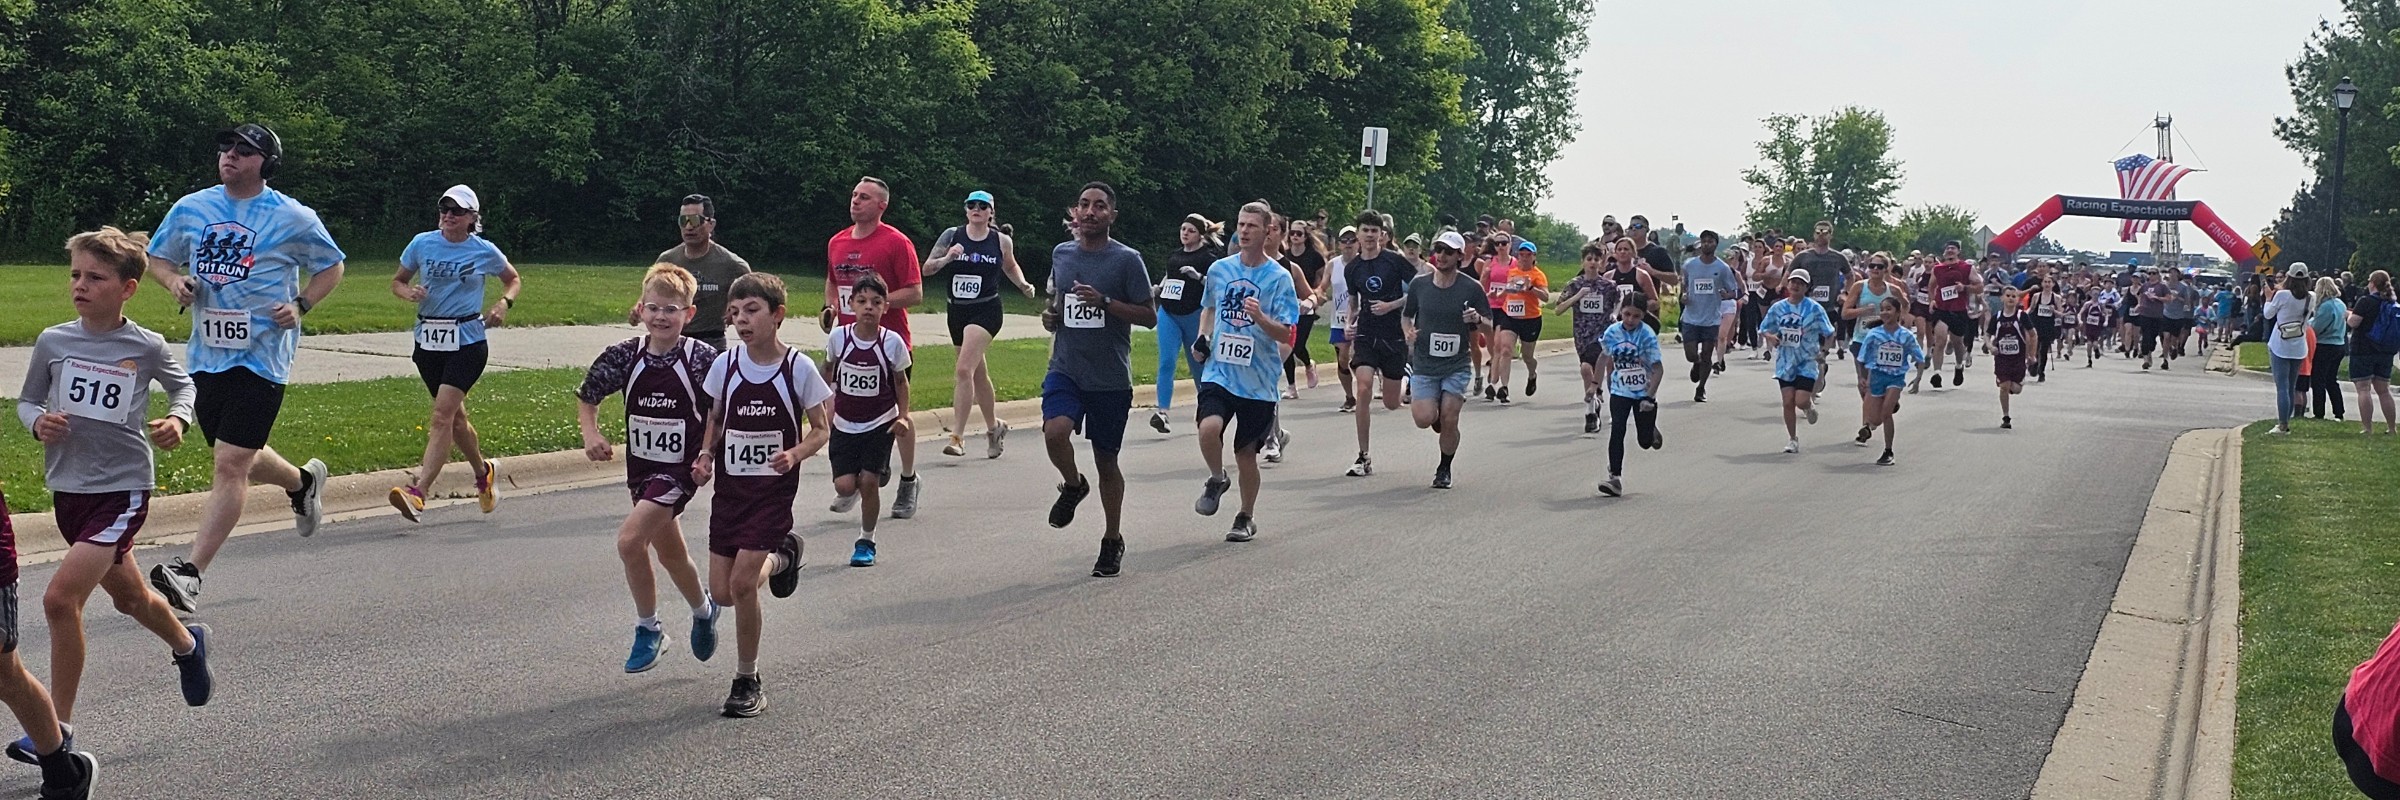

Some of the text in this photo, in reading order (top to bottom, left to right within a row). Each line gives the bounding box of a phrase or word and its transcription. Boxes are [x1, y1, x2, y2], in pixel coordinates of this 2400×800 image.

[2066, 200, 2188, 216] Racing Expectations
[2014, 213, 2044, 238] START
[2207, 222, 2237, 248] FINISH
[198, 262, 246, 277] 911 RUN
[426, 259, 460, 270] FLEET
[427, 269, 456, 278] FEET
[955, 281, 980, 293] 1469
[1066, 304, 1103, 320] 1264
[1507, 304, 1524, 312] 1207
[1583, 300, 1600, 310] 505
[1222, 310, 1236, 319] 911
[203, 319, 248, 340] 1165
[423, 328, 456, 344] 1471
[1220, 341, 1252, 359] 1162
[1434, 340, 1454, 352] 501
[1879, 352, 1902, 362] 1139
[71, 361, 130, 378] Racing Expectations
[842, 372, 878, 389] 1263
[1620, 373, 1646, 386] 1483
[69, 376, 122, 409] 518
[638, 396, 677, 409] WILDCATS
[736, 405, 777, 416] WILDCATS
[631, 428, 682, 453] 1148
[728, 443, 780, 465] 1455
